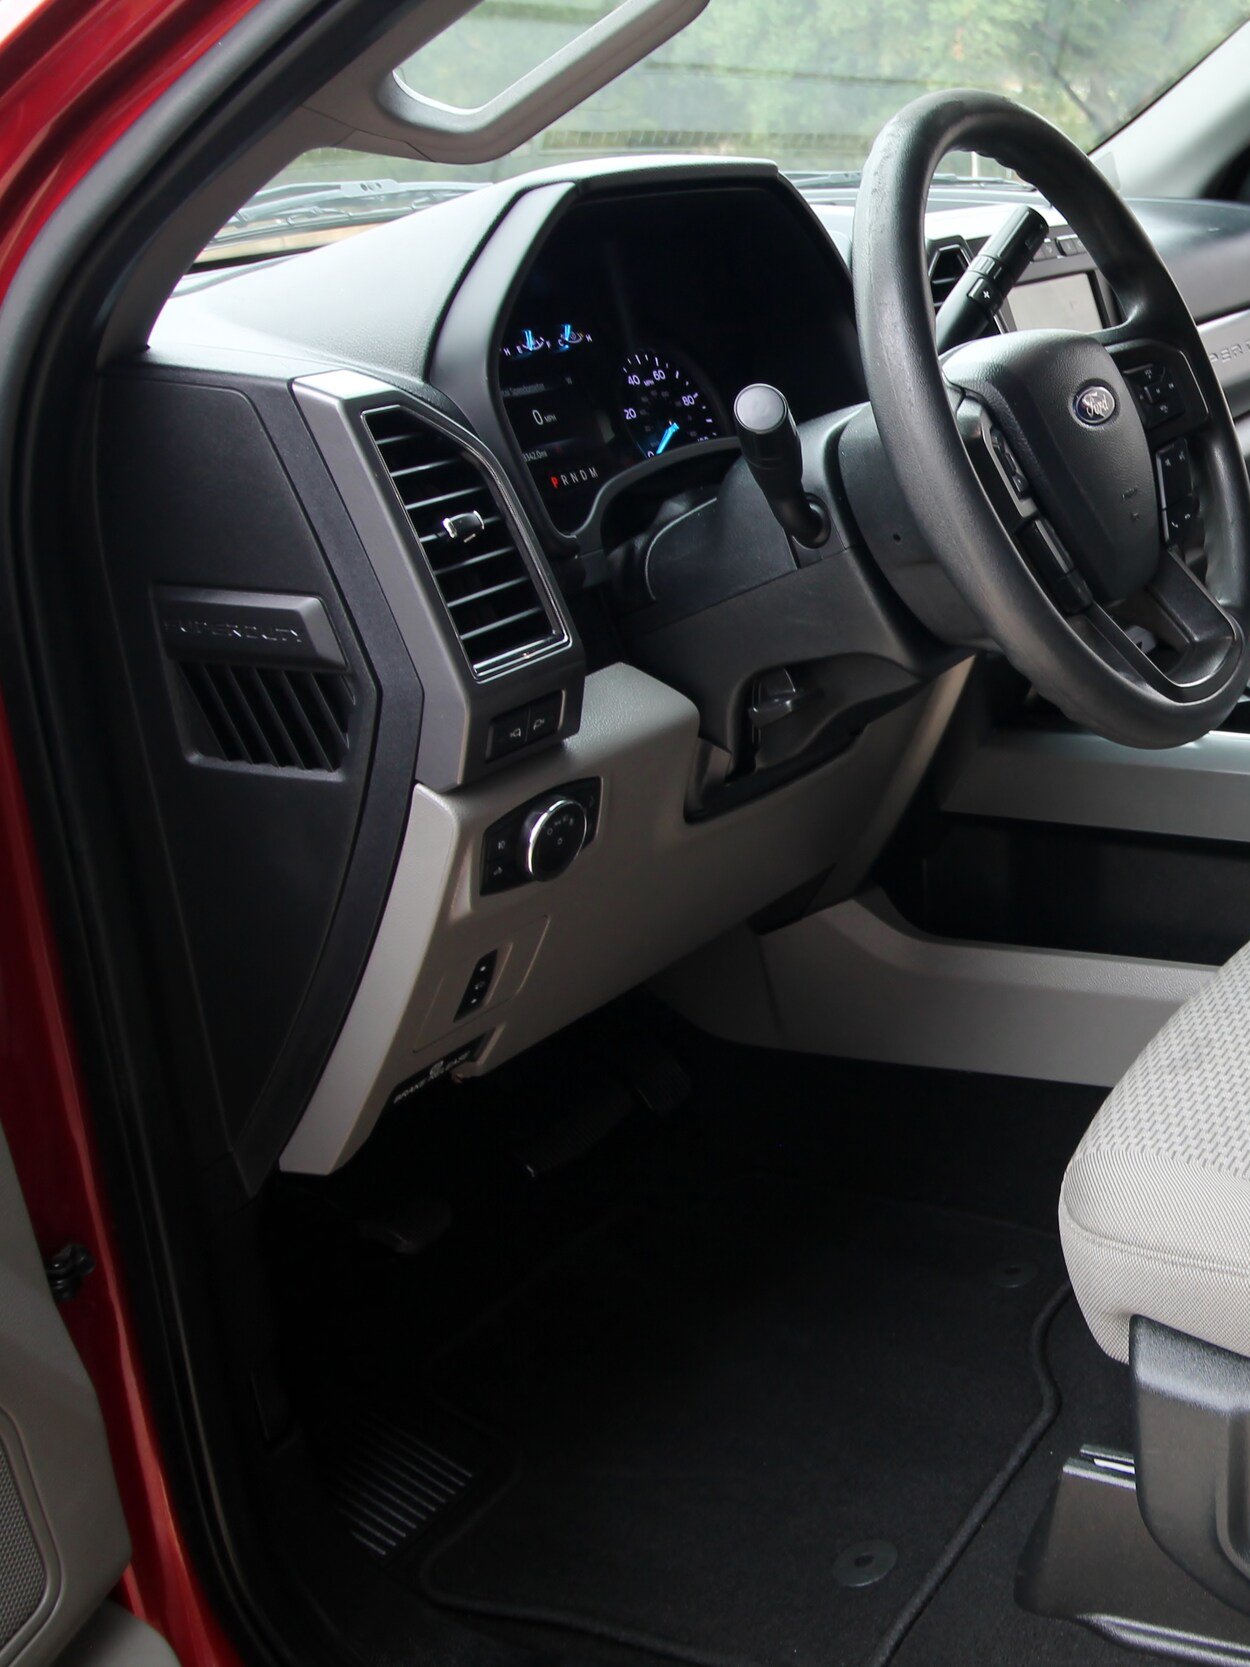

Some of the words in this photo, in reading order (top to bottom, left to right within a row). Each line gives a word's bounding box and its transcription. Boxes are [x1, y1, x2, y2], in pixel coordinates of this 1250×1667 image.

[1209, 343, 1244, 363] PER
[627, 374, 641, 386] 40
[652, 369, 666, 381] 60
[682, 394, 695, 406] 80
[1081, 391, 1109, 418] Ford
[531, 409, 544, 426] 0
[623, 407, 637, 420] 20
[550, 475, 559, 489] P
[560, 474, 570, 486] R
[569, 472, 579, 484] N
[579, 469, 588, 481] D
[588, 466, 599, 479] M
